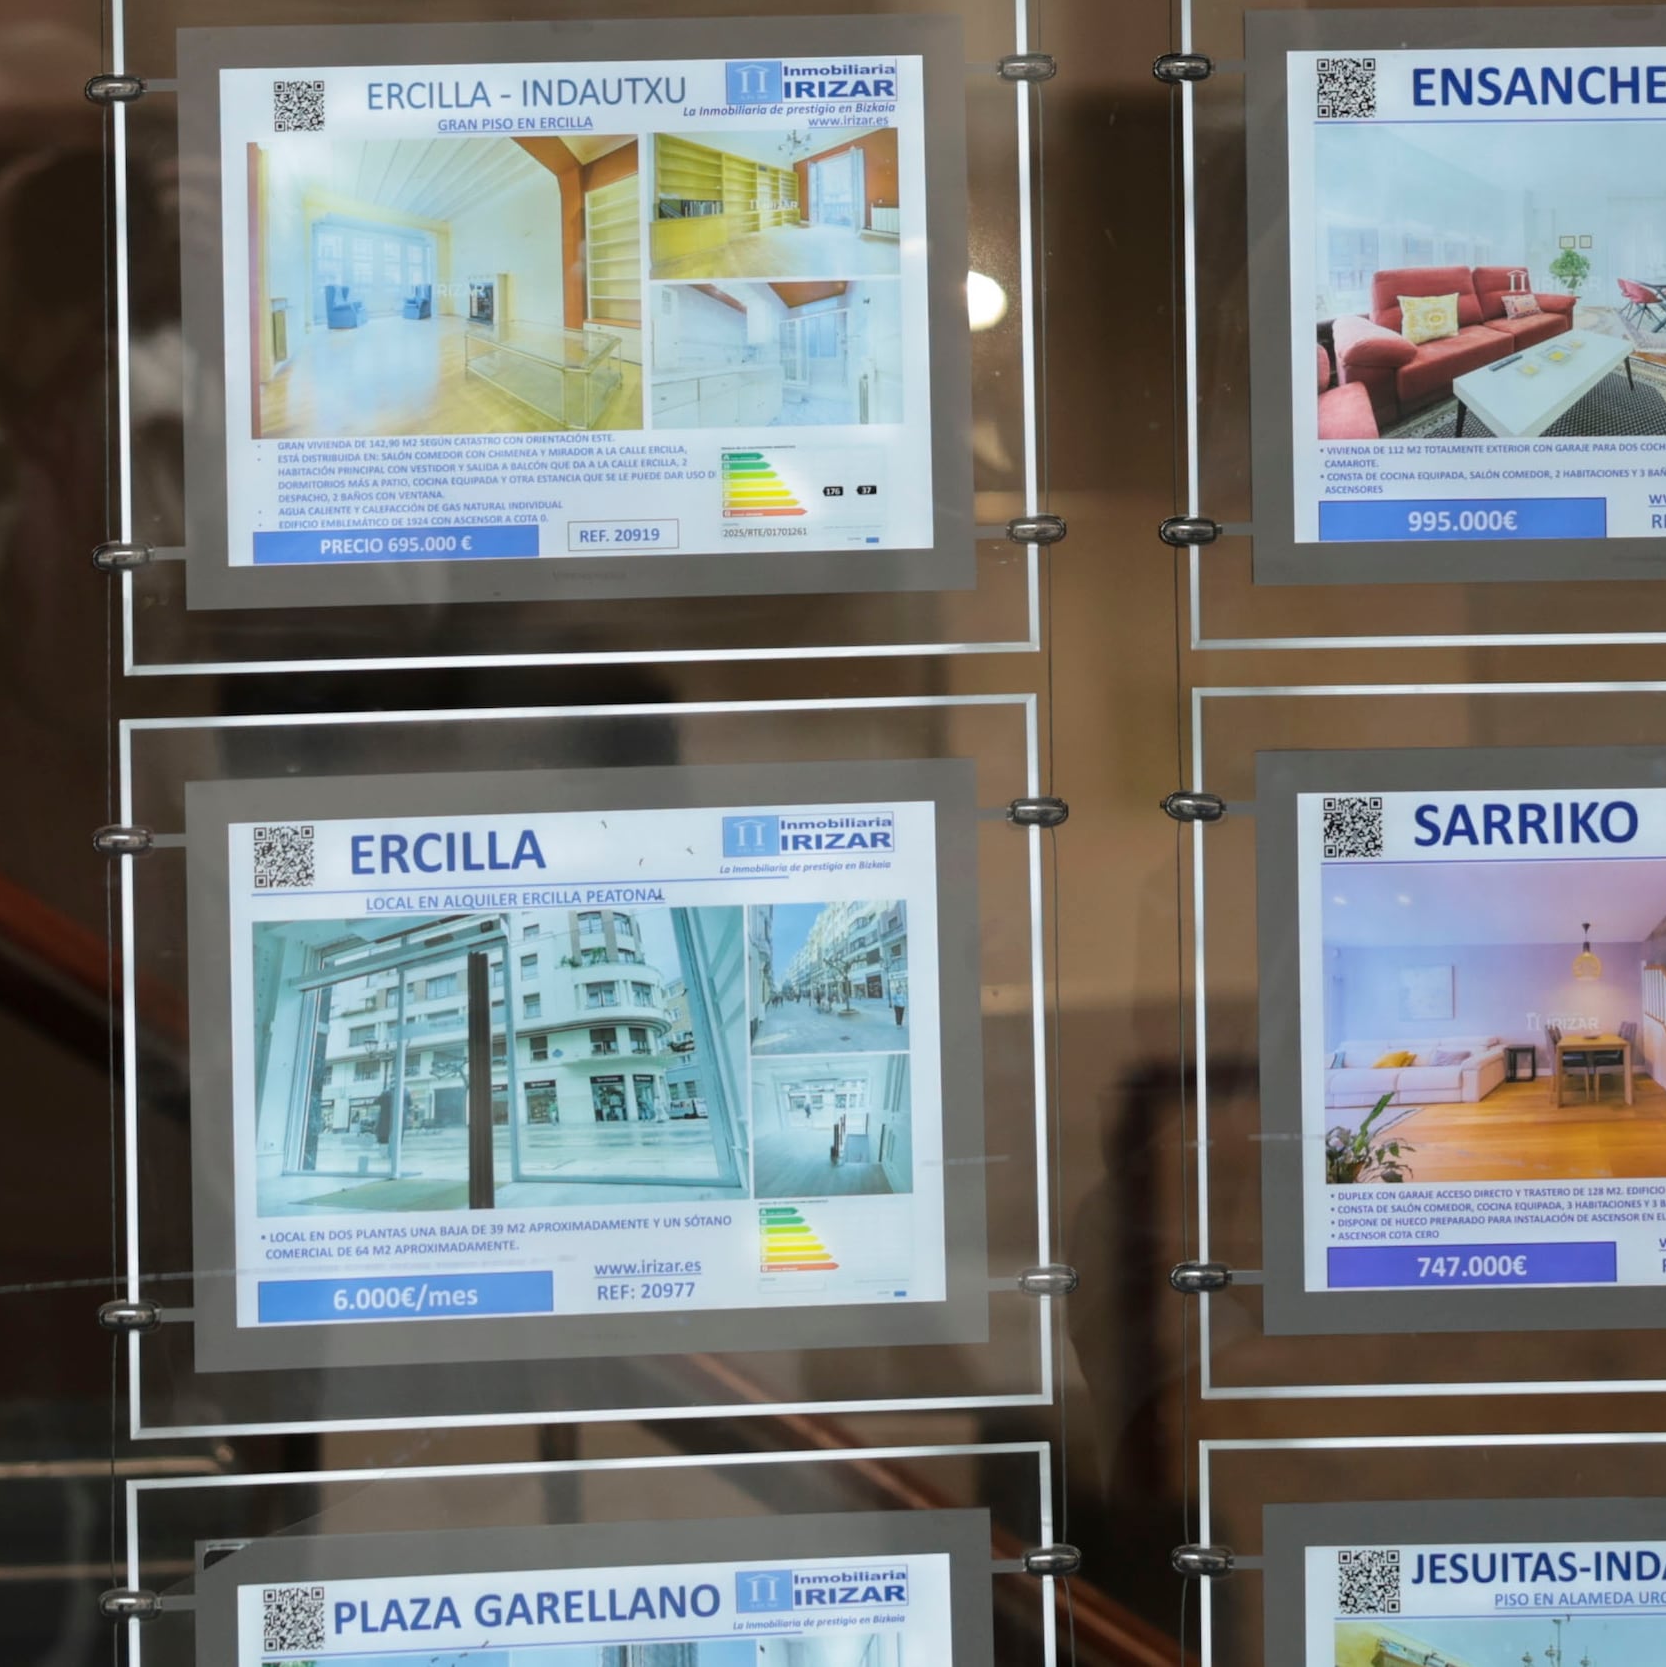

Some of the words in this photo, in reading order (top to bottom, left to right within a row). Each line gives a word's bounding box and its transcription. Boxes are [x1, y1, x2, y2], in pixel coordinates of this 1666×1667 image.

[782, 63, 895, 76] Inmobiliaria
[367, 80, 491, 110] ERCILLA
[522, 75, 687, 107] INDAUTXU
[783, 78, 895, 99] IRIZAR
[437, 118, 478, 131] GRAN
[481, 117, 514, 130] PISO
[517, 116, 536, 130] EN
[539, 115, 594, 130] ERCILLA
[807, 112, 889, 127] www.irizar.es
[1407, 509, 1518, 532] 995.000€
[319, 537, 384, 555] PRECIO
[387, 535, 456, 553] 695.000
[460, 534, 472, 551] €
[579, 528, 610, 543] REF.
[614, 527, 660, 542] 20919
[780, 815, 892, 830] Inmobiliaria
[1414, 799, 1638, 847] SARRIKO
[780, 831, 892, 851] IRIZAR
[350, 828, 546, 875] ERCILLA
[593, 1257, 702, 1277] www.irizar.es
[1416, 1254, 1527, 1278] 747.000€
[332, 1282, 478, 1313] 6.000€/mes
[596, 1283, 635, 1301] REF:
[640, 1281, 695, 1299] 20977
[793, 1569, 906, 1585] Inmobiliaria
[793, 1584, 906, 1606] IRIZAR
[1494, 1592, 1529, 1607] PISO
[1533, 1592, 1554, 1606] EN
[1557, 1590, 1635, 1606] ALAMEDA
[333, 1595, 461, 1635] PLAZA
[473, 1582, 720, 1628] GARELLANO
